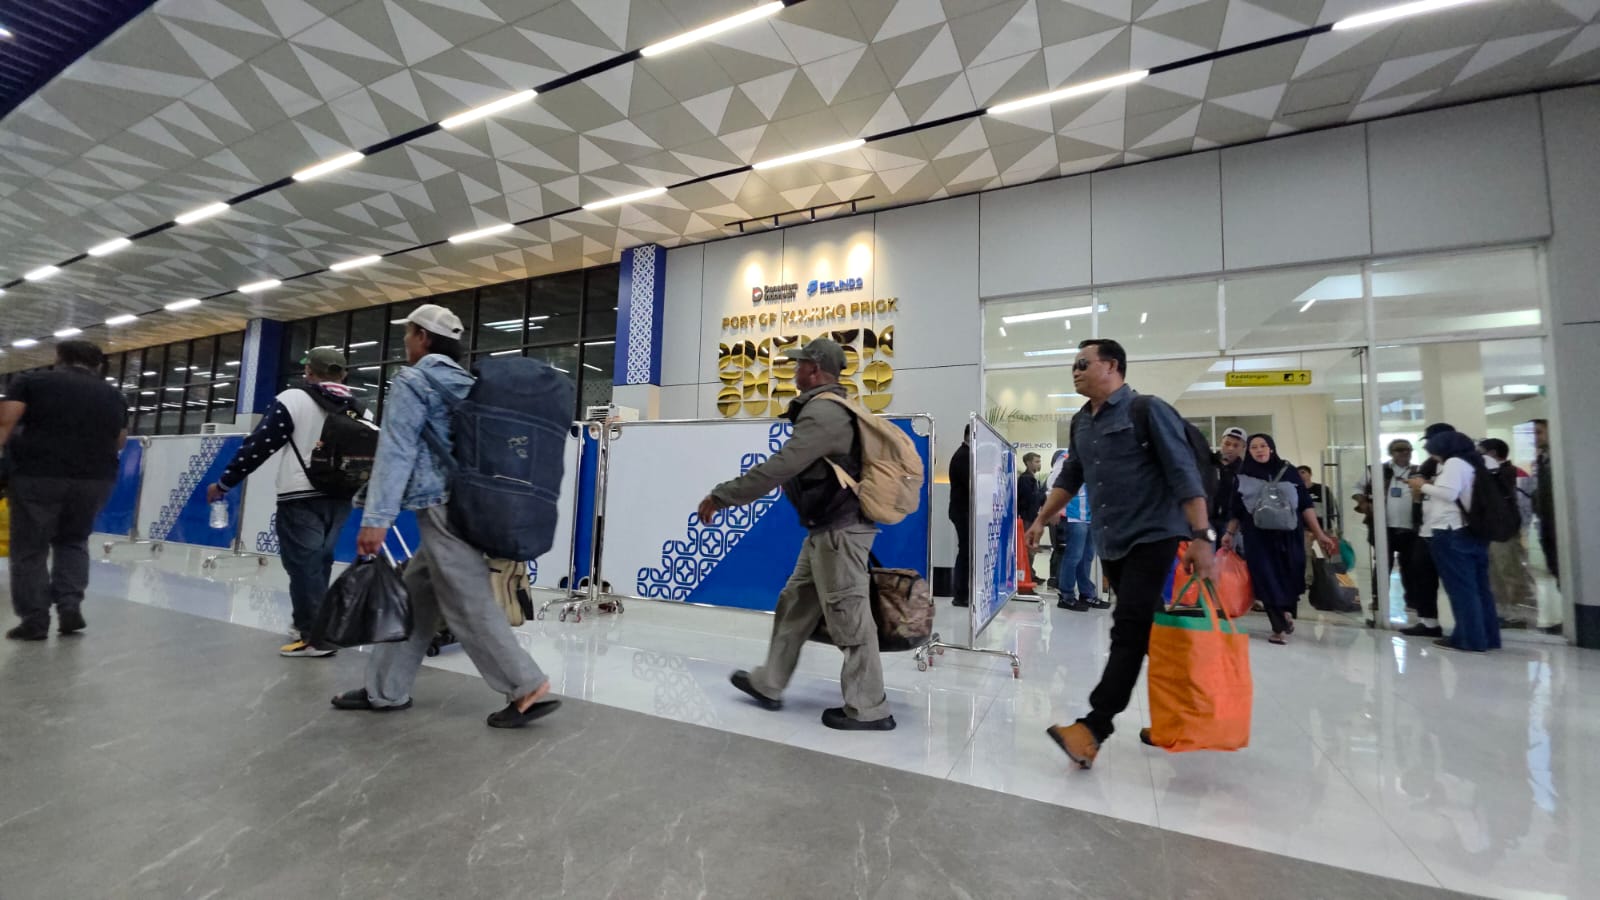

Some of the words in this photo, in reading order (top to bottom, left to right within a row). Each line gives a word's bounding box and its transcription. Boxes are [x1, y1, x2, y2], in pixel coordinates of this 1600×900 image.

[820, 277, 863, 291] PELINDO
[722, 315, 756, 330] PORT
[759, 312, 777, 327] OF
[782, 304, 846, 325] TANJUNG
